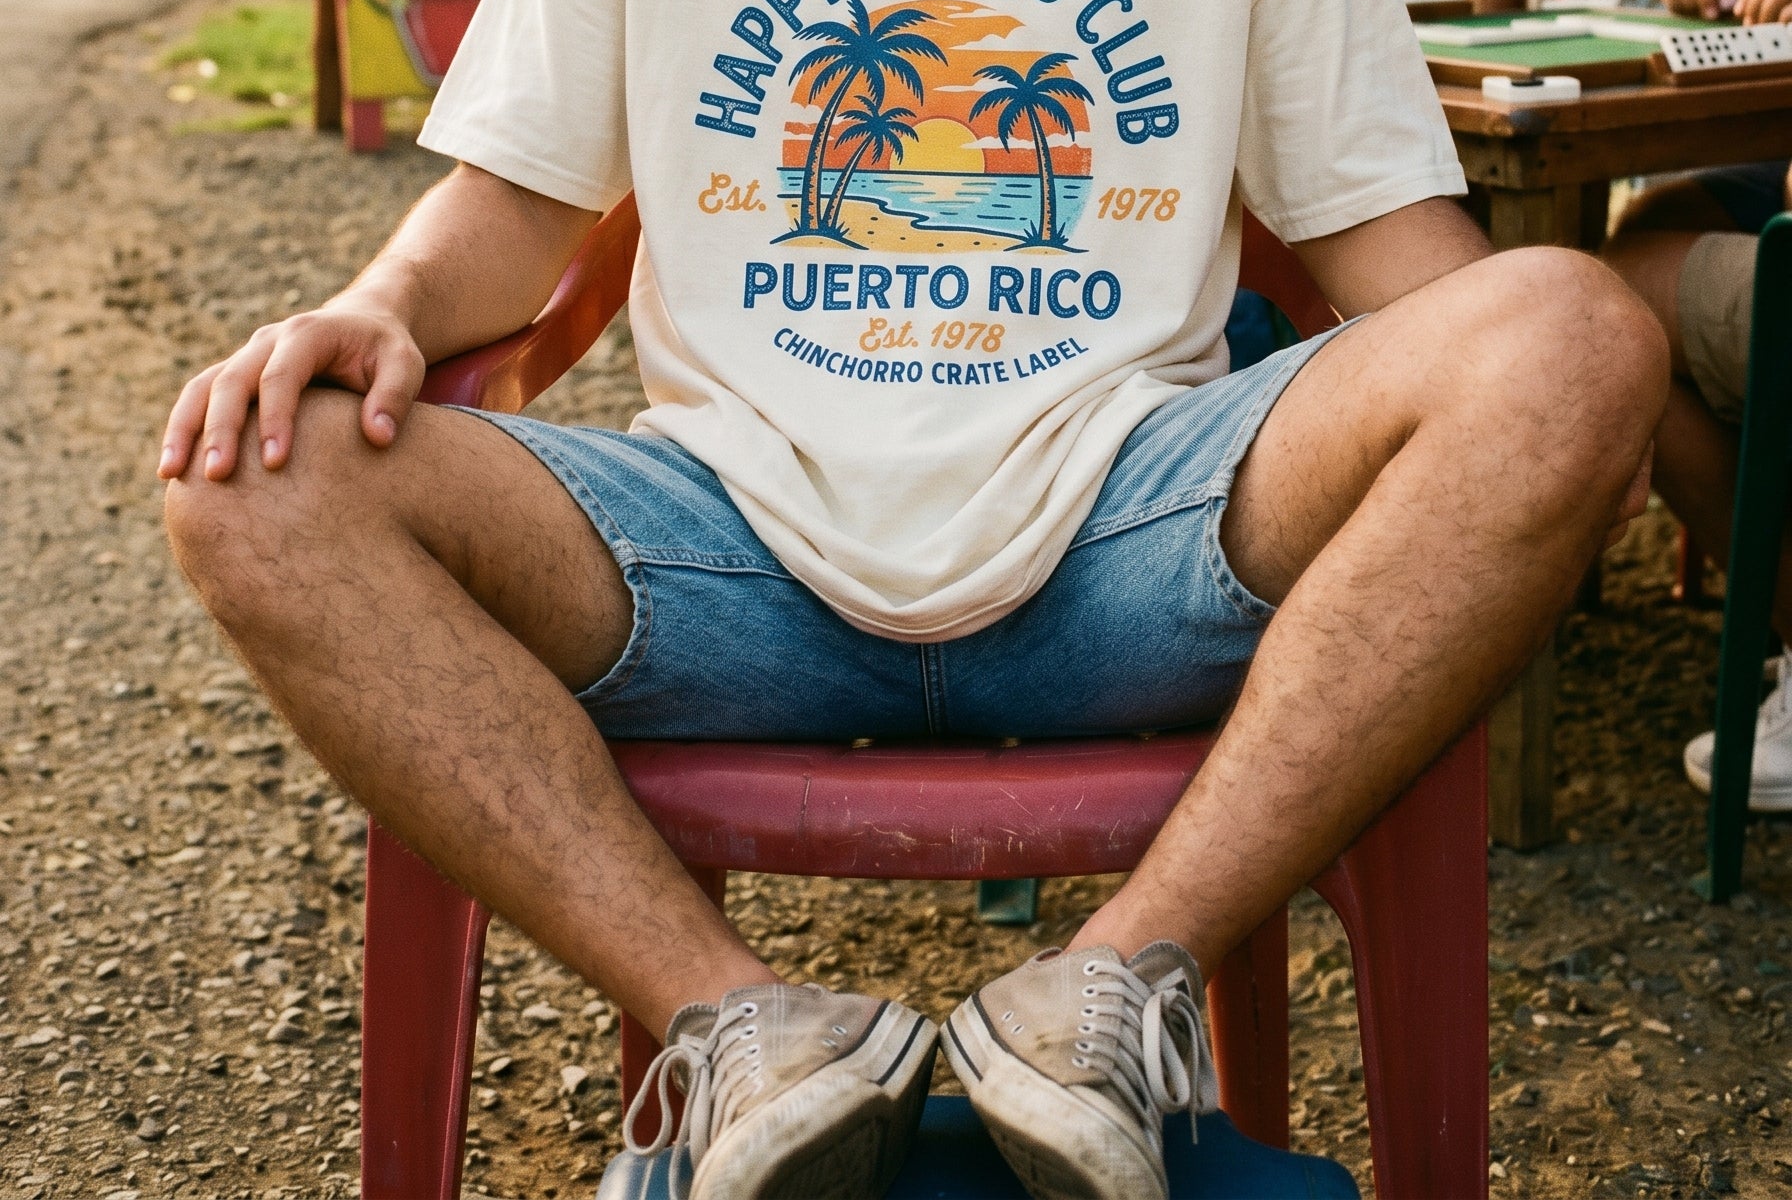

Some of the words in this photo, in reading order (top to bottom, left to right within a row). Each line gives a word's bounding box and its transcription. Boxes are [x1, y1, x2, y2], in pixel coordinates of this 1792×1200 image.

[698, 172, 767, 214] Est.
[1098, 187, 1181, 222] 1978
[743, 262, 969, 312] PUERTO
[988, 265, 1122, 320] RICO
[773, 327, 923, 383] CHINCHORRO
[931, 362, 1009, 385] CRATE
[1014, 336, 1090, 379] LABEL
[858, 317, 918, 353] Est.
[931, 320, 1006, 353] 1978
